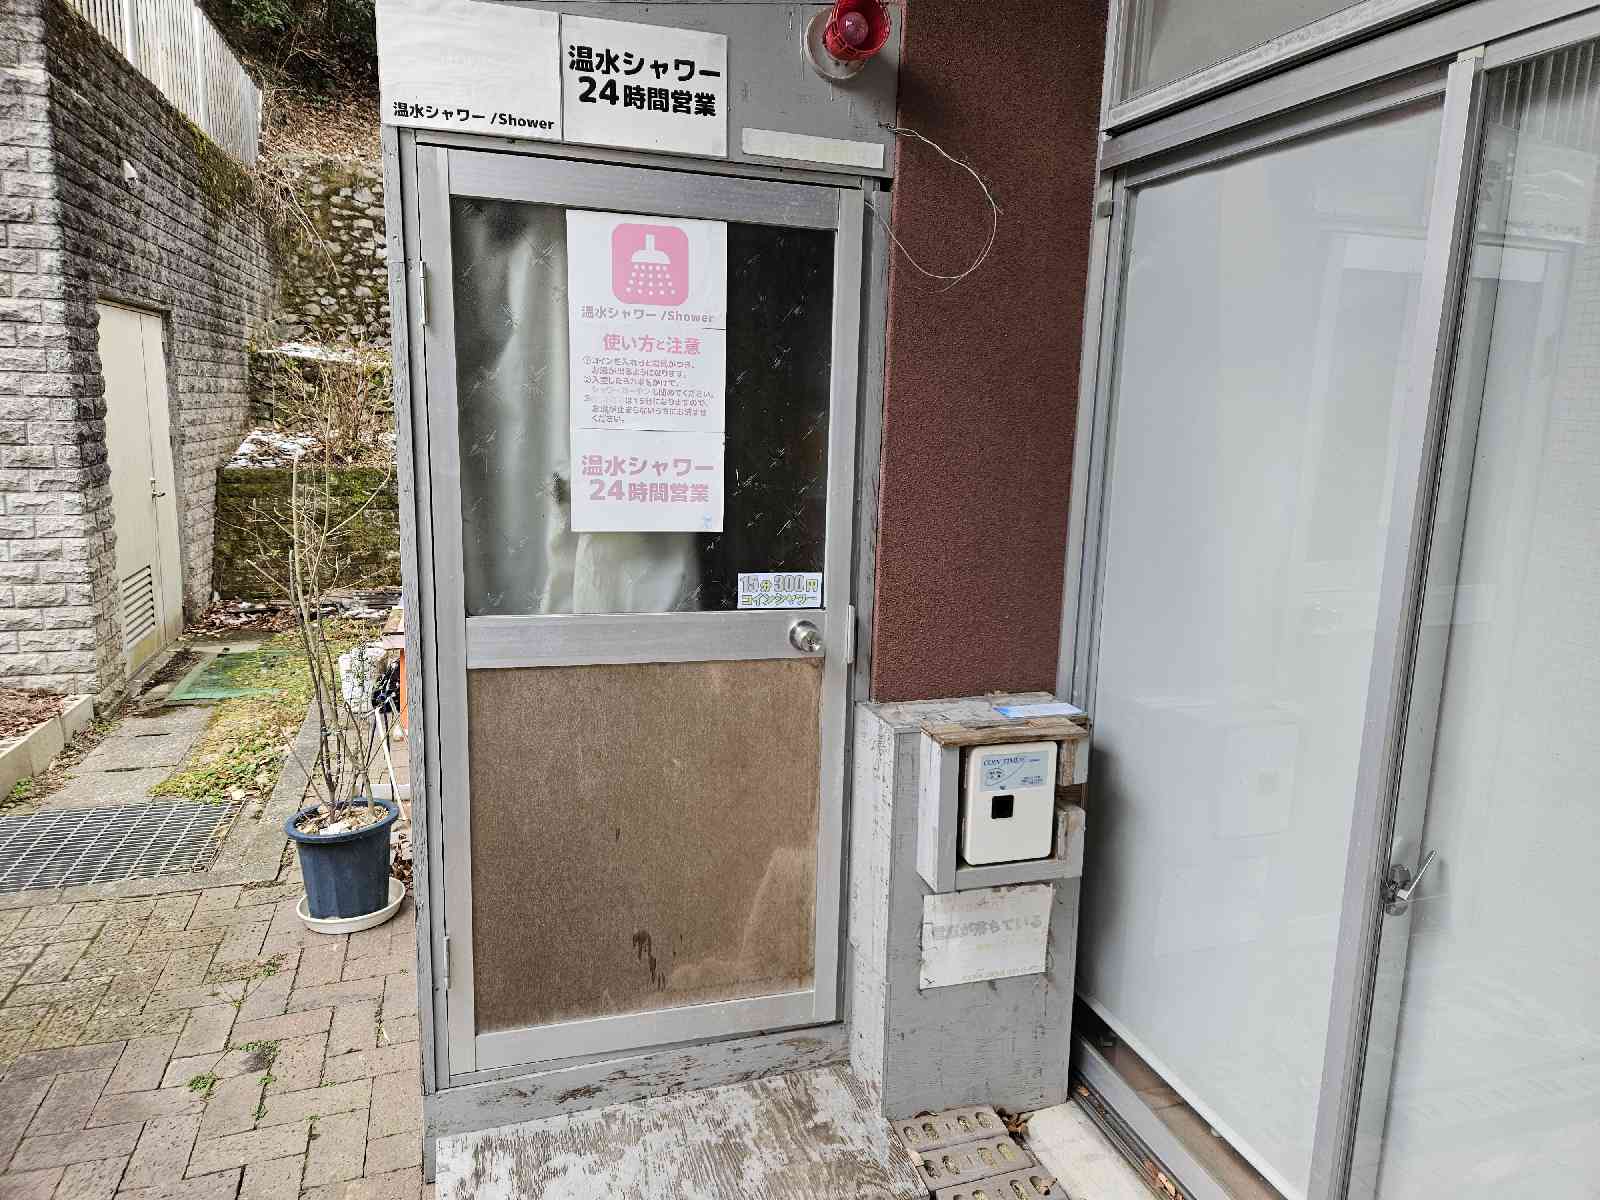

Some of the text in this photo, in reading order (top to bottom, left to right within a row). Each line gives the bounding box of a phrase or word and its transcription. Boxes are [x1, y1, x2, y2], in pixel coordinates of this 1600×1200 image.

[567, 44, 721, 82] 温水シャワー
[578, 76, 717, 117] 24時間営業
[393, 101, 485, 120] 温水シャワー
[581, 305, 657, 321] 温水シャワー
[603, 333, 701, 355] 使い方と注意
[581, 454, 714, 477] 温水シャワー
[589, 479, 709, 503] 24時間営業
